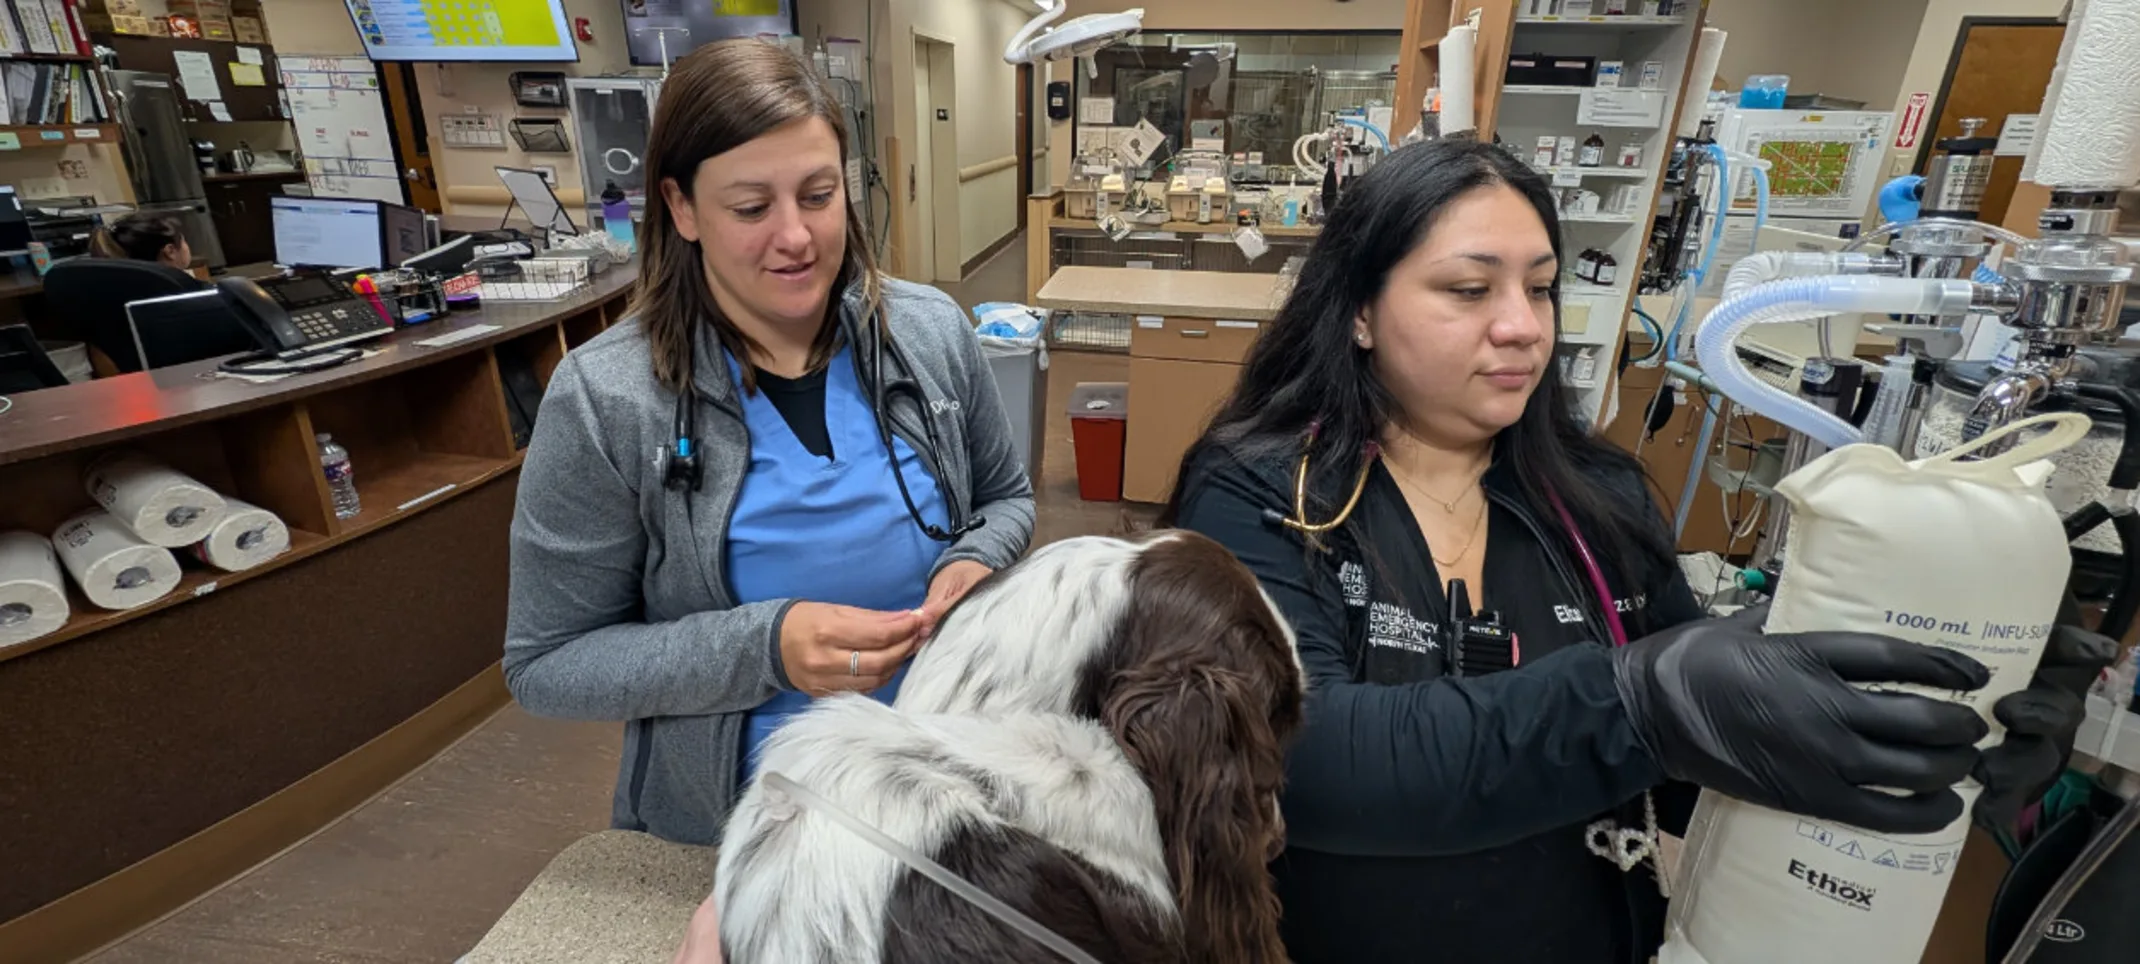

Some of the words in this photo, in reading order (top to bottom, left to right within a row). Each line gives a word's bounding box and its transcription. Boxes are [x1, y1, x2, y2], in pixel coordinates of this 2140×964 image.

[1370, 602, 1414, 618] ANIMAL
[1369, 623, 1425, 642] HOSPITAL
[1370, 612, 1439, 634] EMERGENCY
[1883, 609, 1936, 631] 1000
[1940, 620, 1972, 636] mL
[1788, 858, 1874, 907] Ethox
[2057, 924, 2078, 938] Ltr
